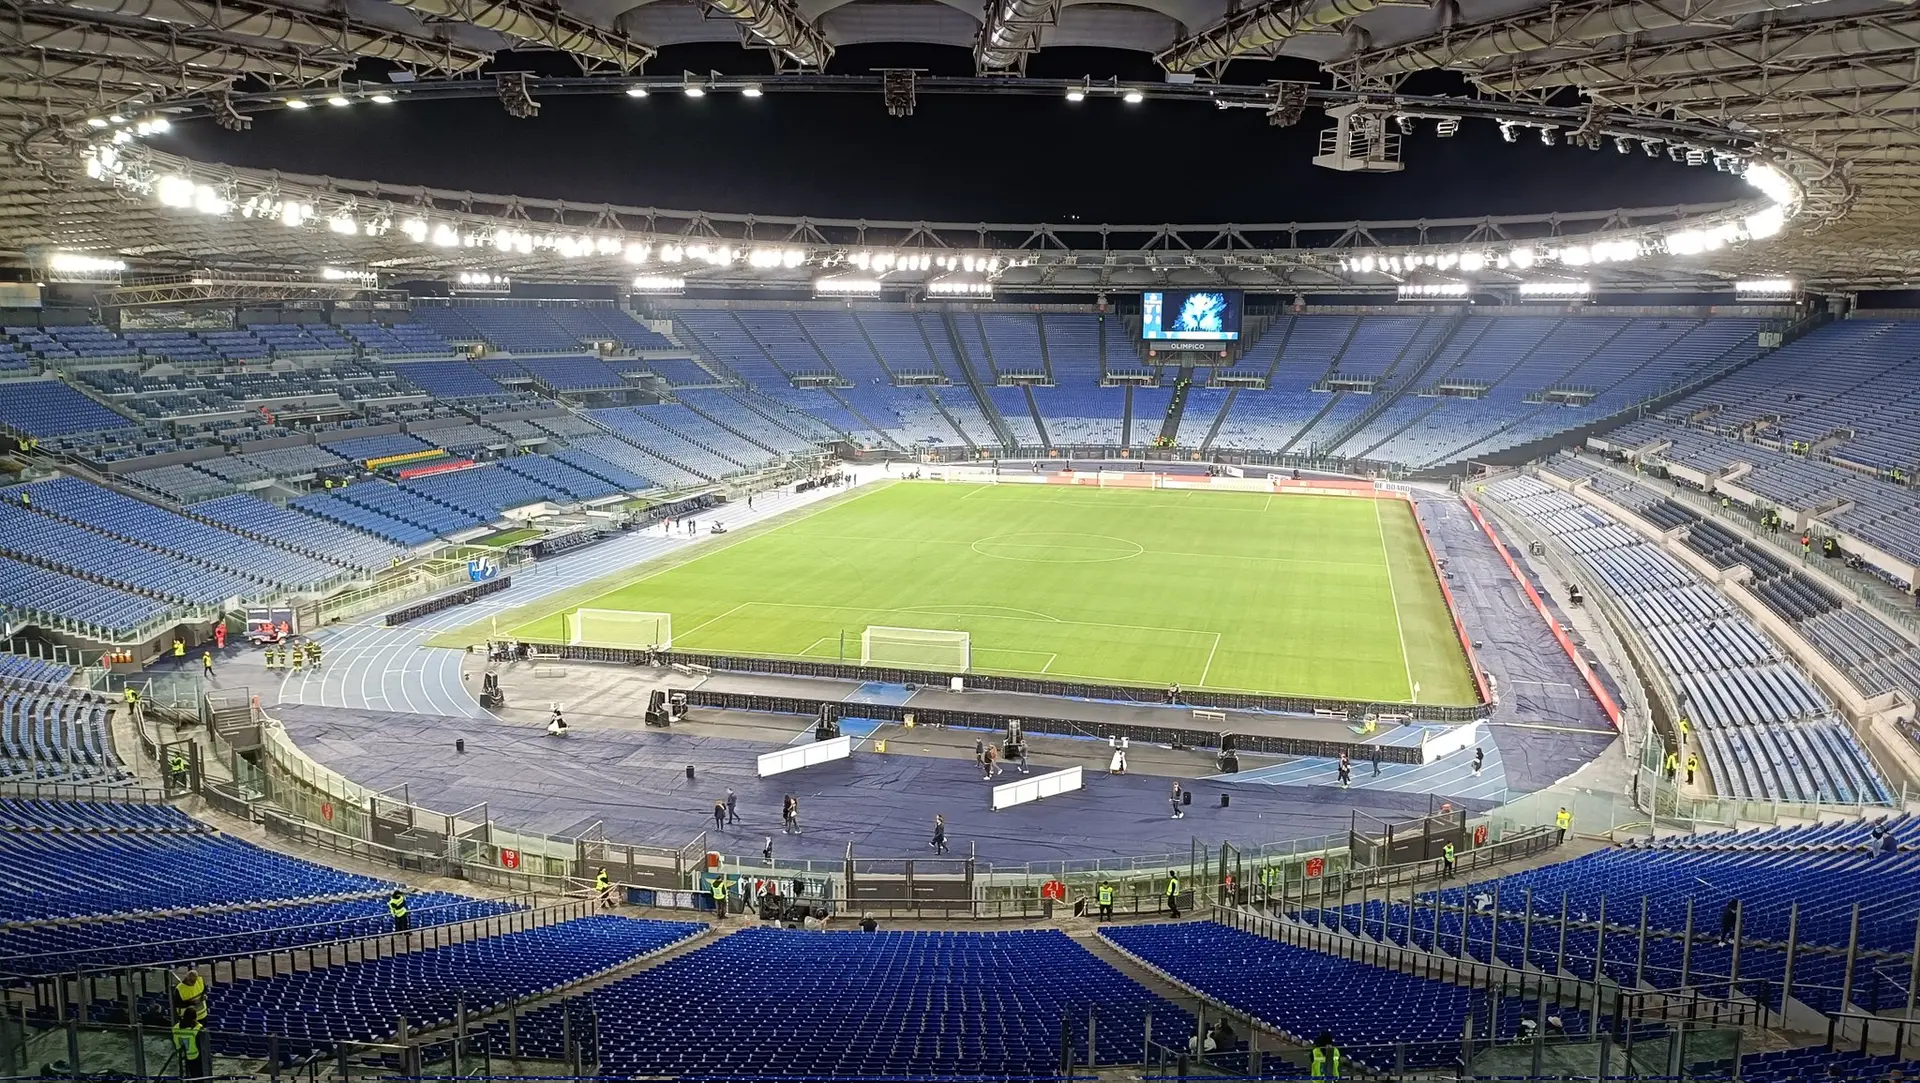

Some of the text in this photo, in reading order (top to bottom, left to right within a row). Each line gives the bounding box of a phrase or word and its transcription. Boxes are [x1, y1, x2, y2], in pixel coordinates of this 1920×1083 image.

[505, 850, 515, 859] 19
[507, 860, 514, 868] B
[1311, 859, 1322, 867] 22
[1312, 868, 1319, 876] B
[1047, 881, 1059, 891] 21
